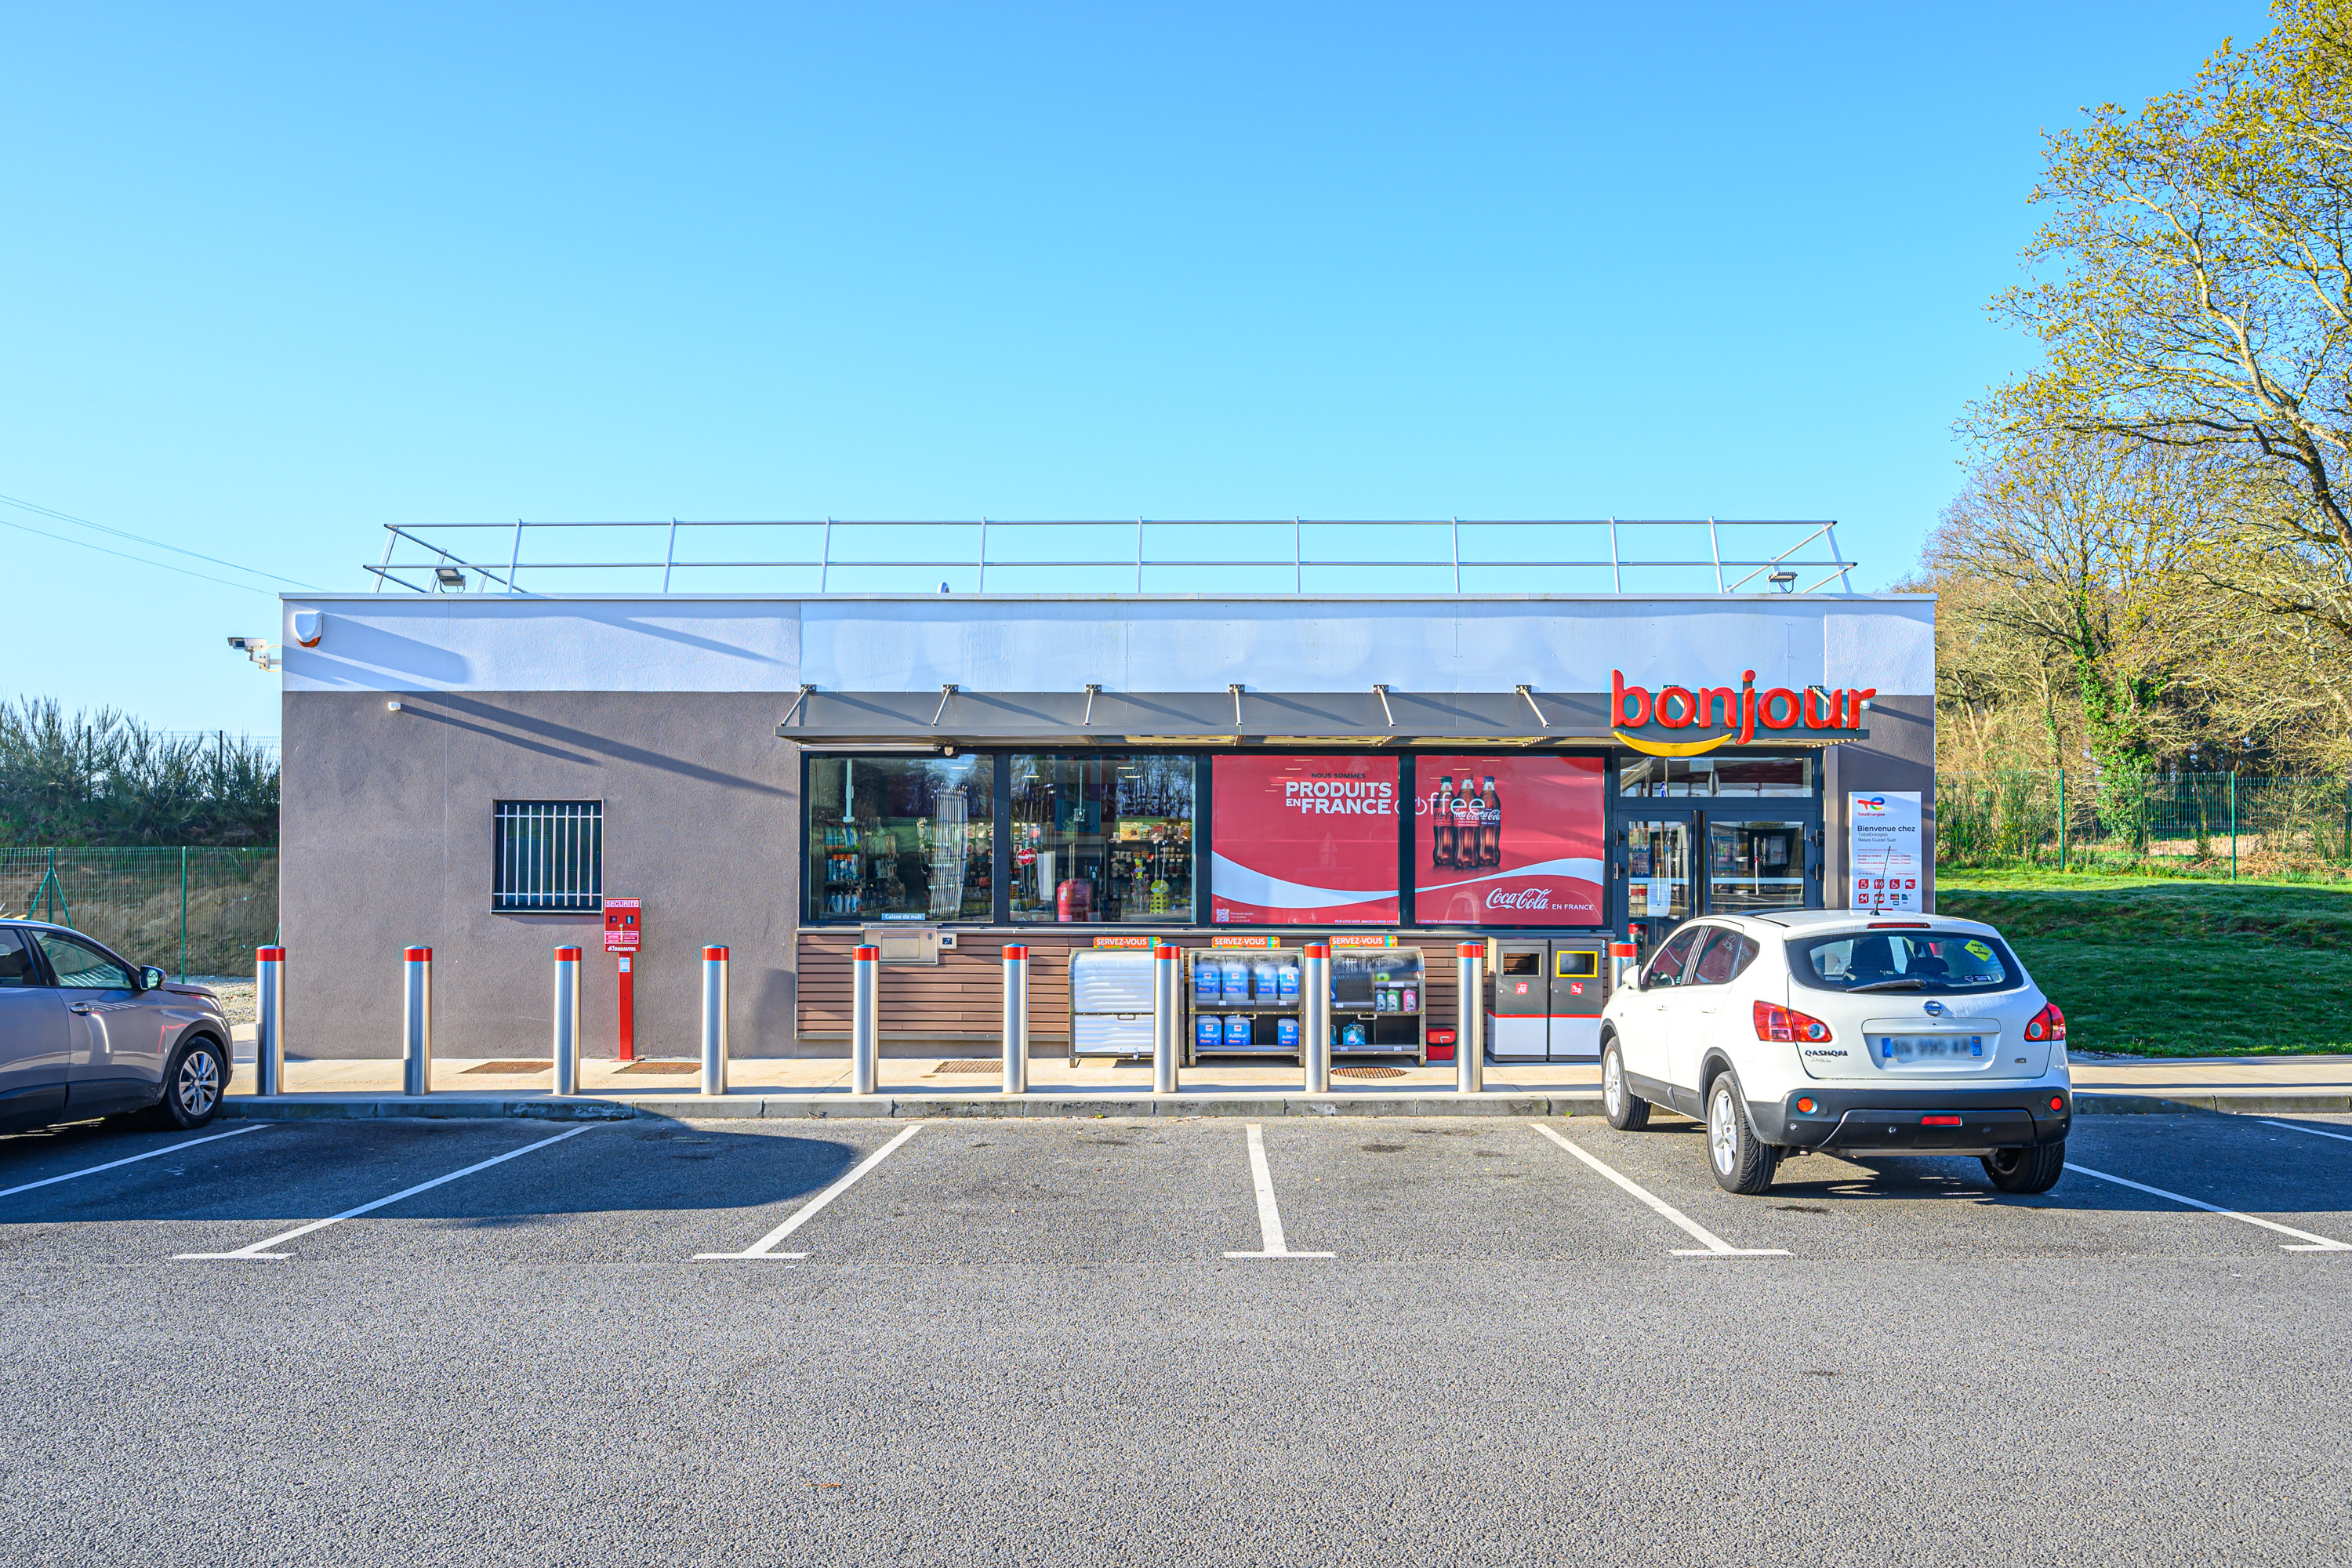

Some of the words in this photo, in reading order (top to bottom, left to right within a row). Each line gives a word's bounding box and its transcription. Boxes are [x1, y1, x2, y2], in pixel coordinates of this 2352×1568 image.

[1610, 669, 1877, 745] bonjour
[1286, 782, 1392, 797] PRODUITS
[1301, 798, 1392, 815] FRANCE
[1394, 792, 1486, 815] offee
[1486, 887, 1552, 909] Coca-Cola
